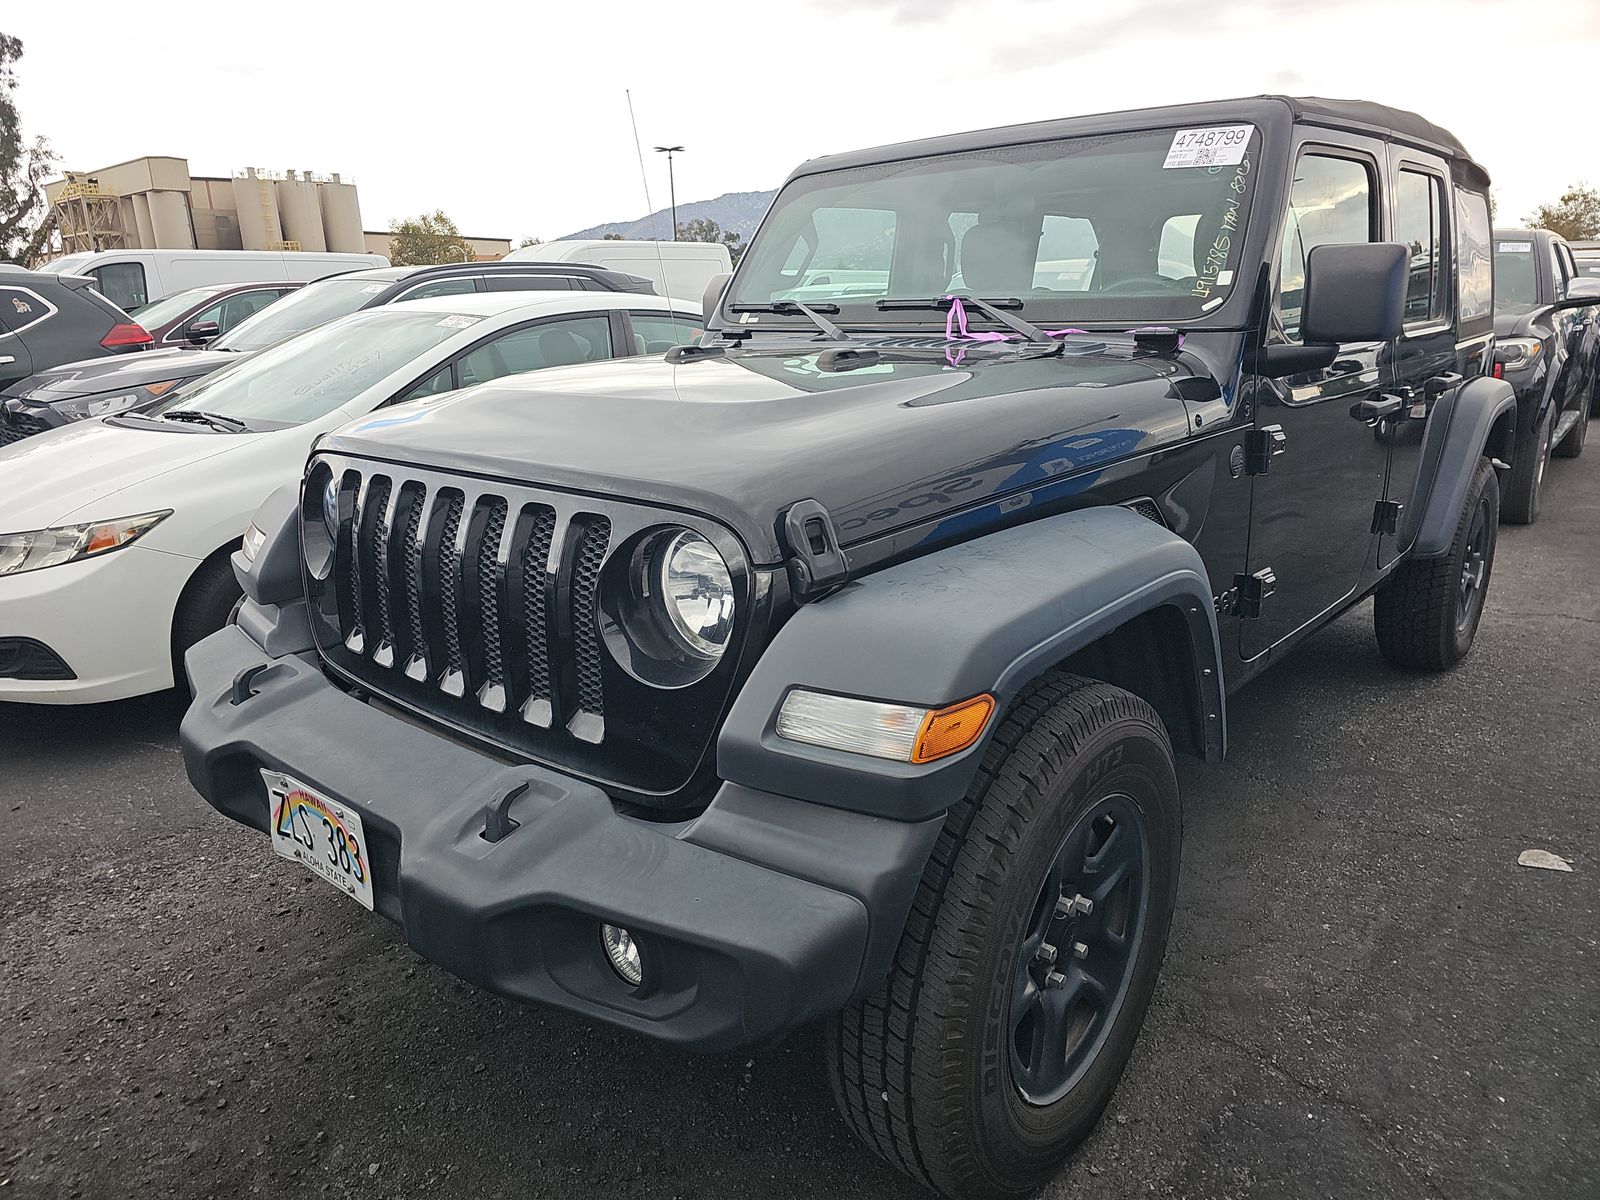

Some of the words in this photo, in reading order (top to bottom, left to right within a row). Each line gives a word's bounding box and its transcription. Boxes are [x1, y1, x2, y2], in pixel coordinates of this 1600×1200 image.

[1176, 130, 1246, 148] 4748799
[298, 789, 328, 814] HAWAII
[272, 788, 314, 851] ZLS
[322, 817, 365, 884] 383
[302, 852, 325, 873] ALOHA
[325, 866, 348, 888] STATE
